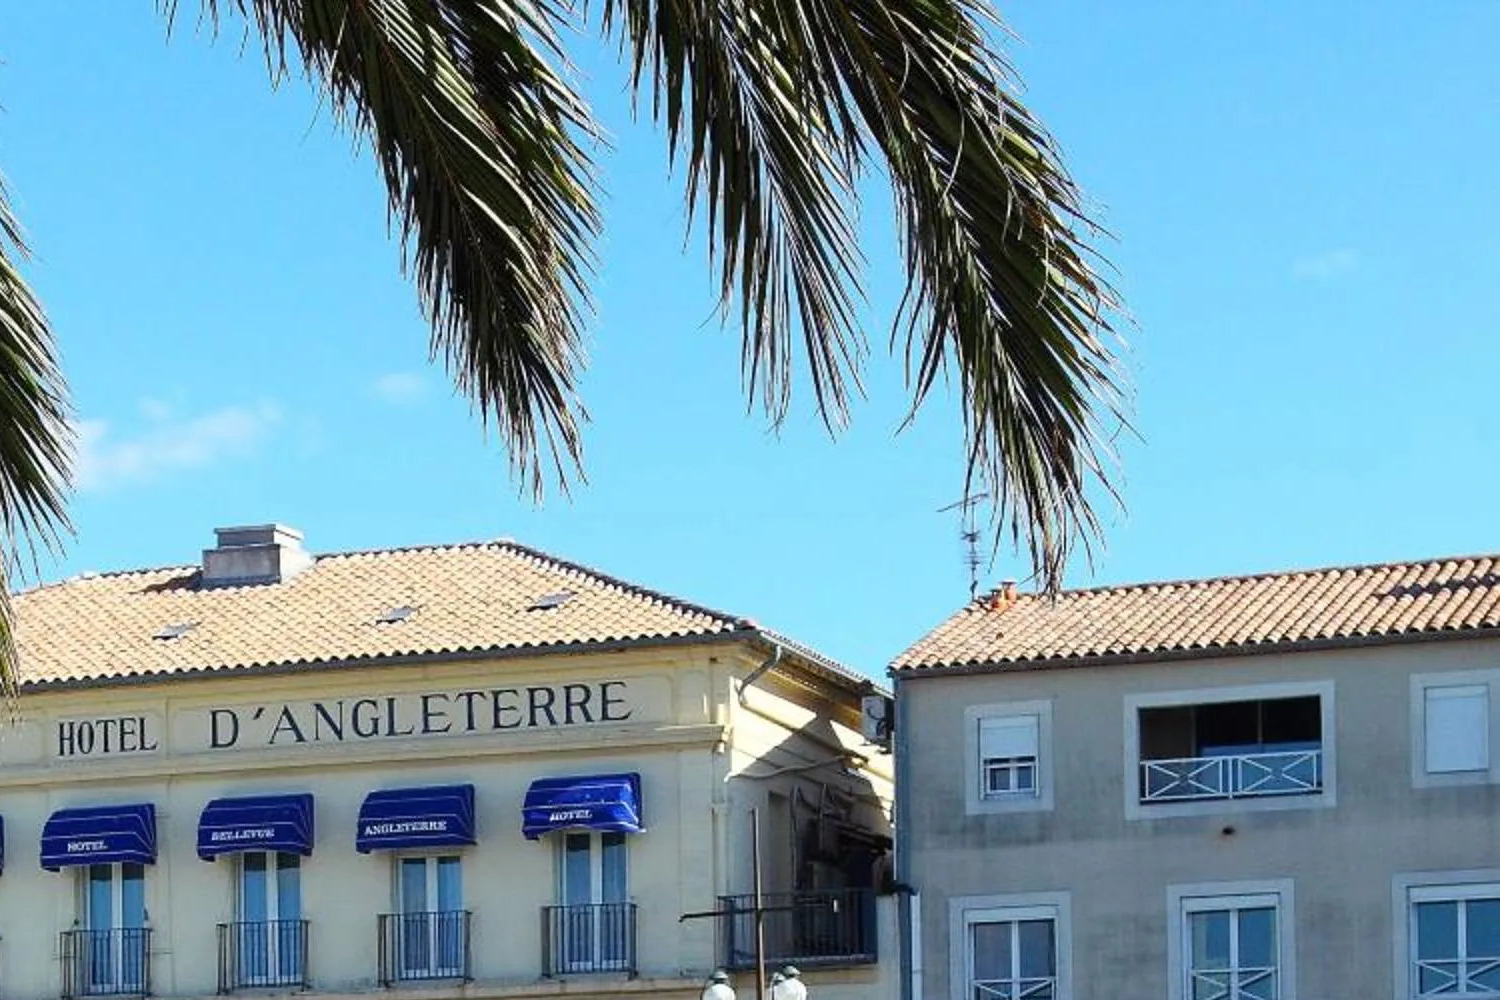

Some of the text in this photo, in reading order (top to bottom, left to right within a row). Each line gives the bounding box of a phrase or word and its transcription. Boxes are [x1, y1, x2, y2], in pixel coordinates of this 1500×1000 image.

[59, 717, 157, 756] HOTEL
[210, 681, 632, 748] D'ANGLETERRE
[549, 809, 593, 822] HOTEL
[211, 829, 275, 841] BELLEVUE
[364, 821, 447, 836] ANGLETERRE
[67, 841, 108, 853] HOTEL
